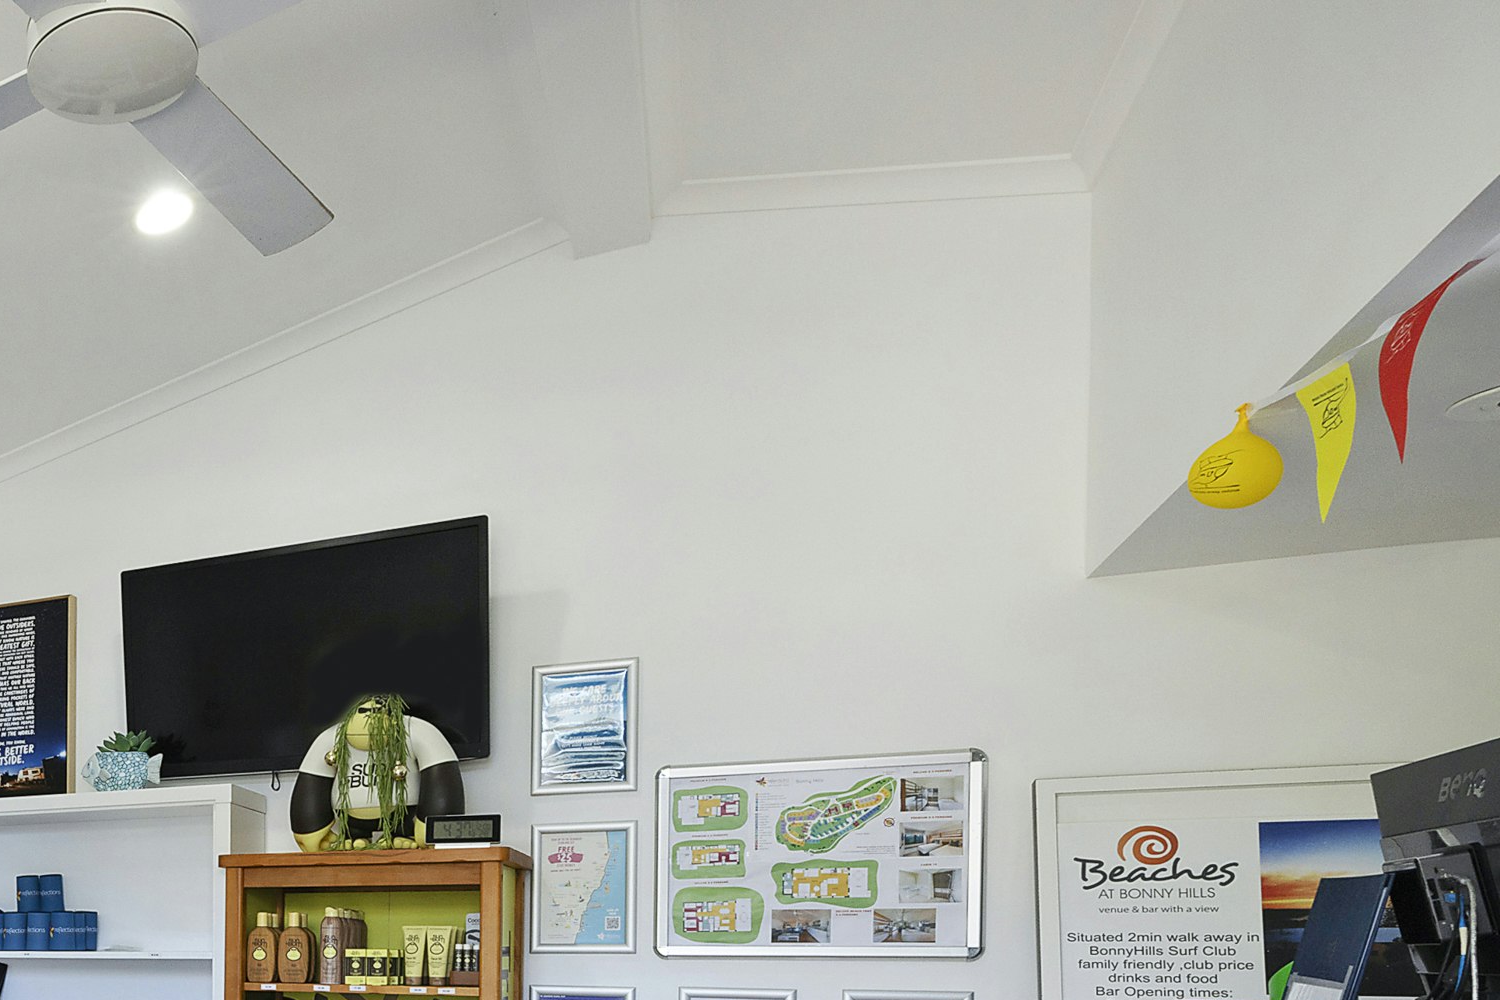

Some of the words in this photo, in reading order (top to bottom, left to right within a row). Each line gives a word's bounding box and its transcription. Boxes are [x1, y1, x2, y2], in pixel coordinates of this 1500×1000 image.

[5, 744, 34, 756] BETTER
[1073, 857, 1239, 890] Beaches
[1098, 888, 1115, 899] AT
[1120, 888, 1173, 899] BONNY
[1179, 887, 1216, 898] HILLS
[1099, 906, 1129, 914] venue
[1132, 905, 1139, 913] &
[1141, 905, 1158, 913] bar
[1160, 905, 1183, 913] with
[1194, 905, 1219, 913] view
[1067, 932, 1123, 943] Situated
[1128, 932, 1162, 942] 2min
[1166, 932, 1199, 943] walk
[1204, 934, 1242, 944] away
[1247, 932, 1260, 942] in
[1089, 946, 1164, 958] BonnyHills
[1168, 945, 1198, 956] Surf
[1202, 946, 1236, 956] Club
[1078, 959, 1118, 972] family
[1123, 959, 1174, 972] friendly
[1218, 960, 1254, 972] price
[1109, 972, 1150, 984] drinks
[1155, 973, 1182, 984] and
[1187, 973, 1218, 984] food
[1096, 986, 1120, 996] Bar
[1124, 986, 1184, 1000] Opening
[1190, 987, 1232, 998] times:
